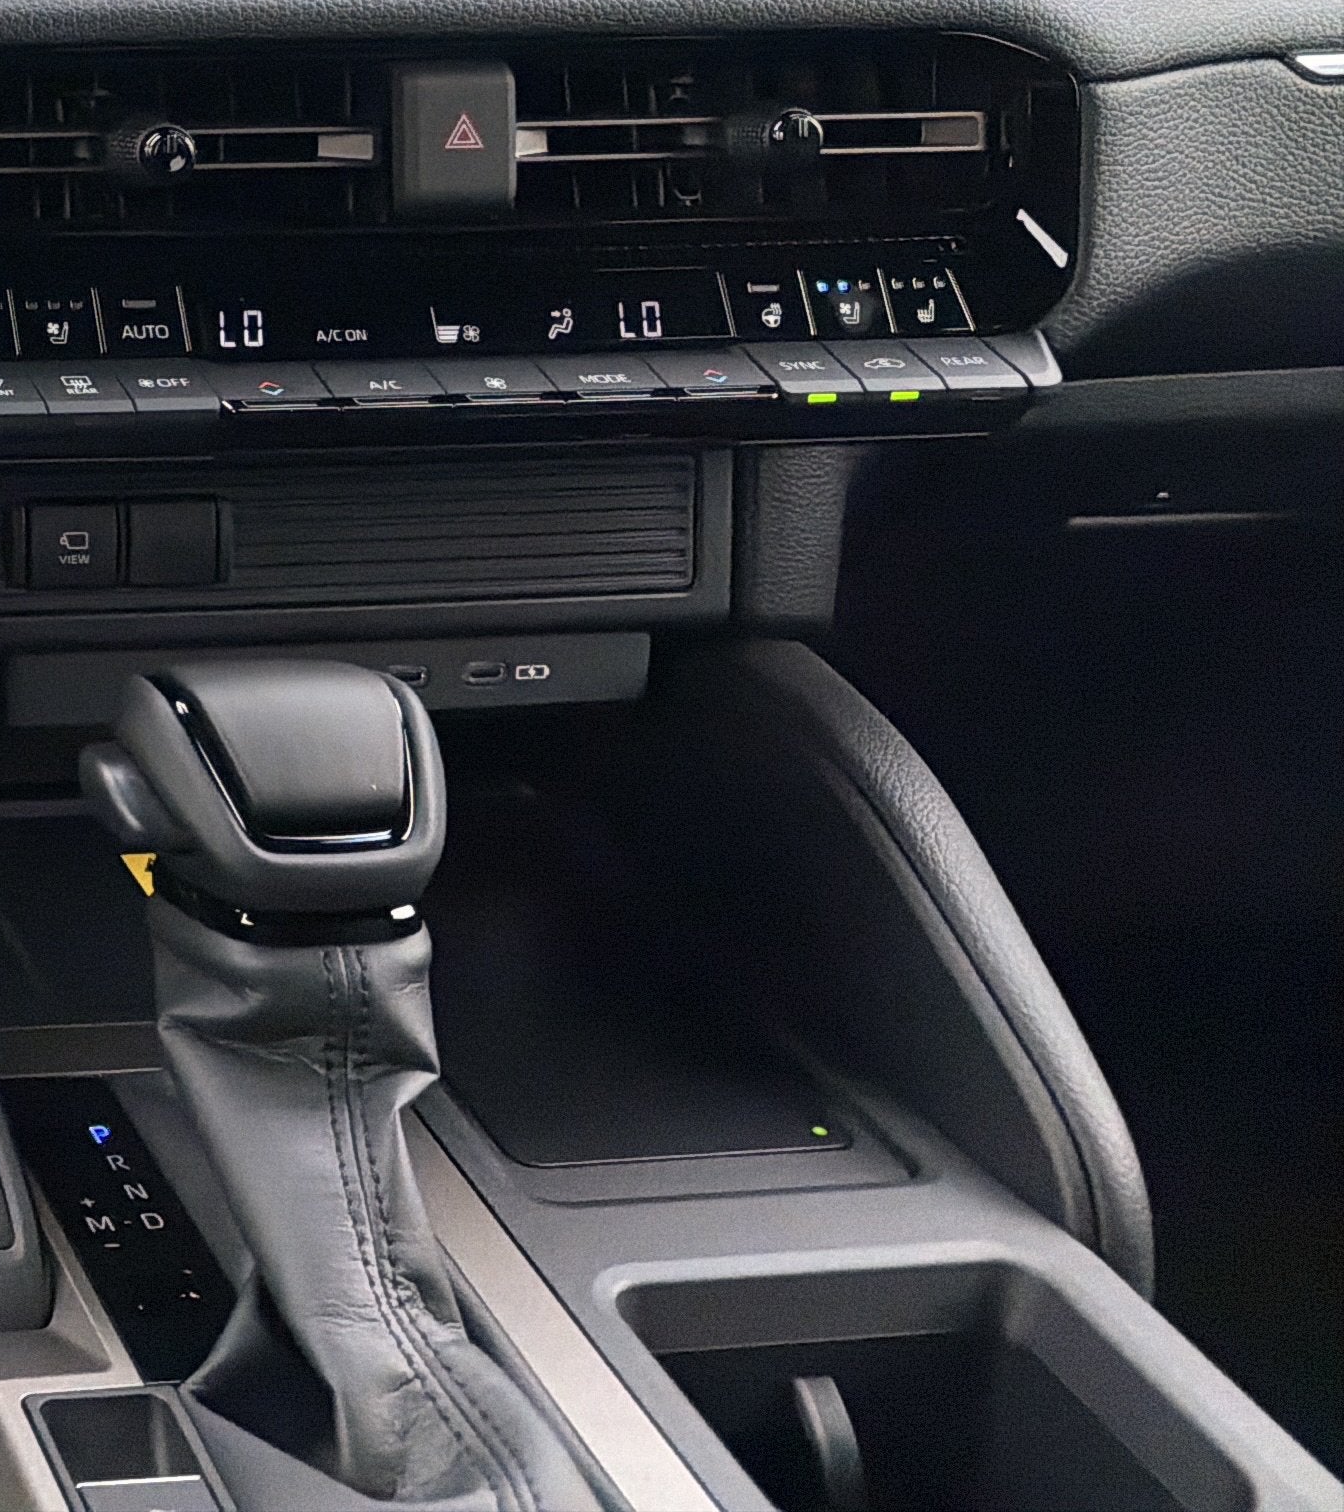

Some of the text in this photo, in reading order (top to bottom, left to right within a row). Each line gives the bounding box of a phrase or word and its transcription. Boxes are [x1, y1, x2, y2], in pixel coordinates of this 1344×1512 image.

[122, 325, 169, 340] AUTO
[780, 360, 825, 371] SYNC
[941, 356, 985, 367] REAR
[157, 378, 189, 387] OFF
[580, 374, 631, 384] MODE
[66, 386, 99, 394] REAR
[370, 381, 401, 389] A/C
[58, 554, 90, 564] VIEW
[89, 1126, 110, 1144] P
[108, 1155, 130, 1170] R
[124, 1184, 149, 1200] N
[86, 1215, 116, 1232] M
[141, 1213, 164, 1229] D
